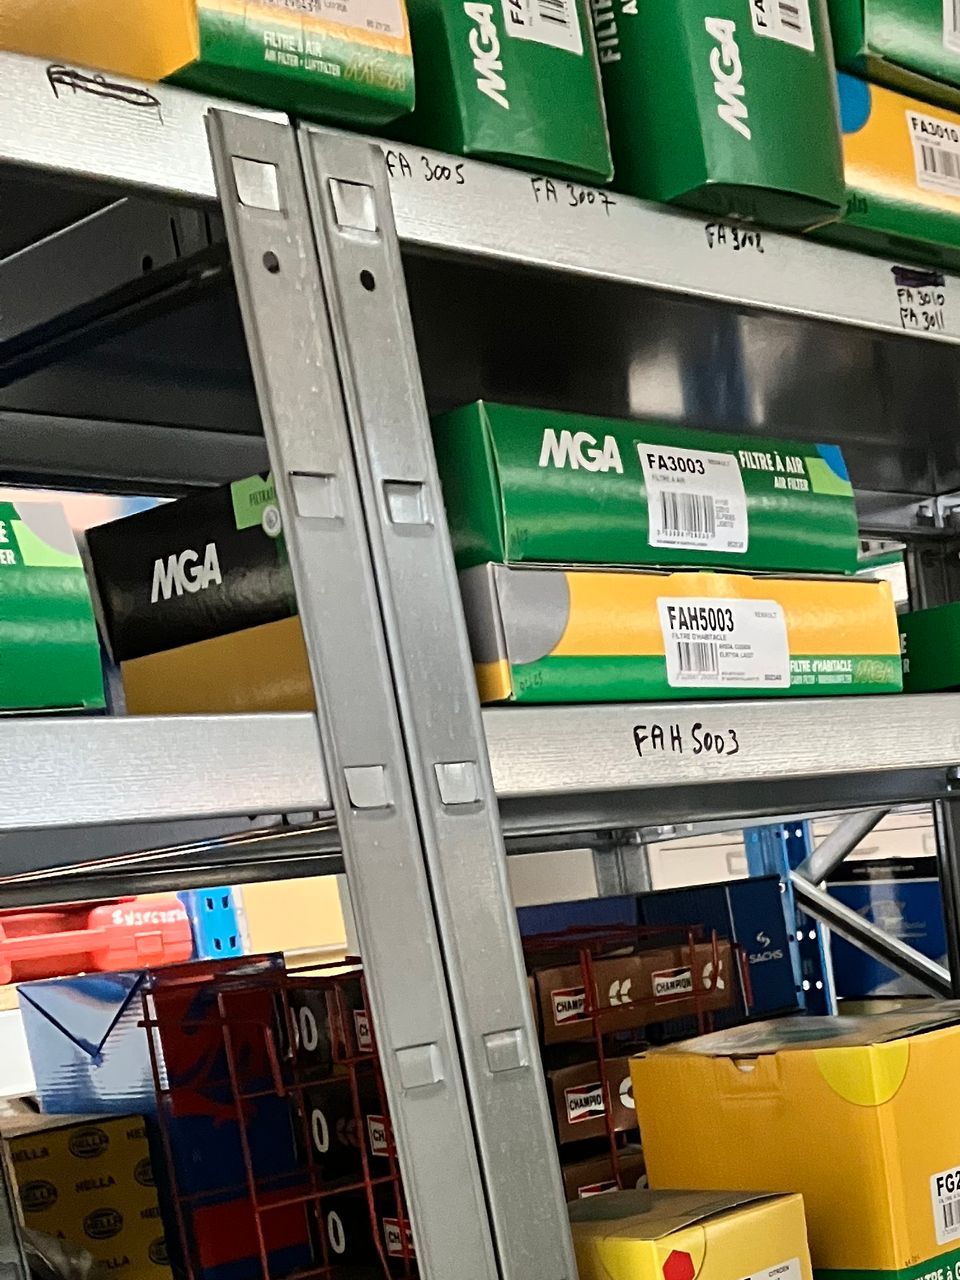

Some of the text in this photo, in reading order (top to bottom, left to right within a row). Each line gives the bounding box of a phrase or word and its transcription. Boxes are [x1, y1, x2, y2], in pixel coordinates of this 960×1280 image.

[463, 2, 509, 109] MGA
[704, 17, 751, 141] MGA
[911, 116, 959, 143] FA3010
[421, 155, 465, 185] 3005
[539, 428, 624, 474] MGA
[646, 453, 706, 475] FA3003
[738, 449, 775, 471] FILTRE
[785, 456, 805, 474] AIR
[151, 542, 223, 604] MGA
[666, 605, 735, 632] FAH5003
[633, 722, 741, 757] FAH 5003
[749, 949, 784, 965] SACHS
[655, 976, 692, 994] CHAMPION
[556, 998, 586, 1015] CHAMP
[569, 1094, 604, 1112] CHAMPIO
